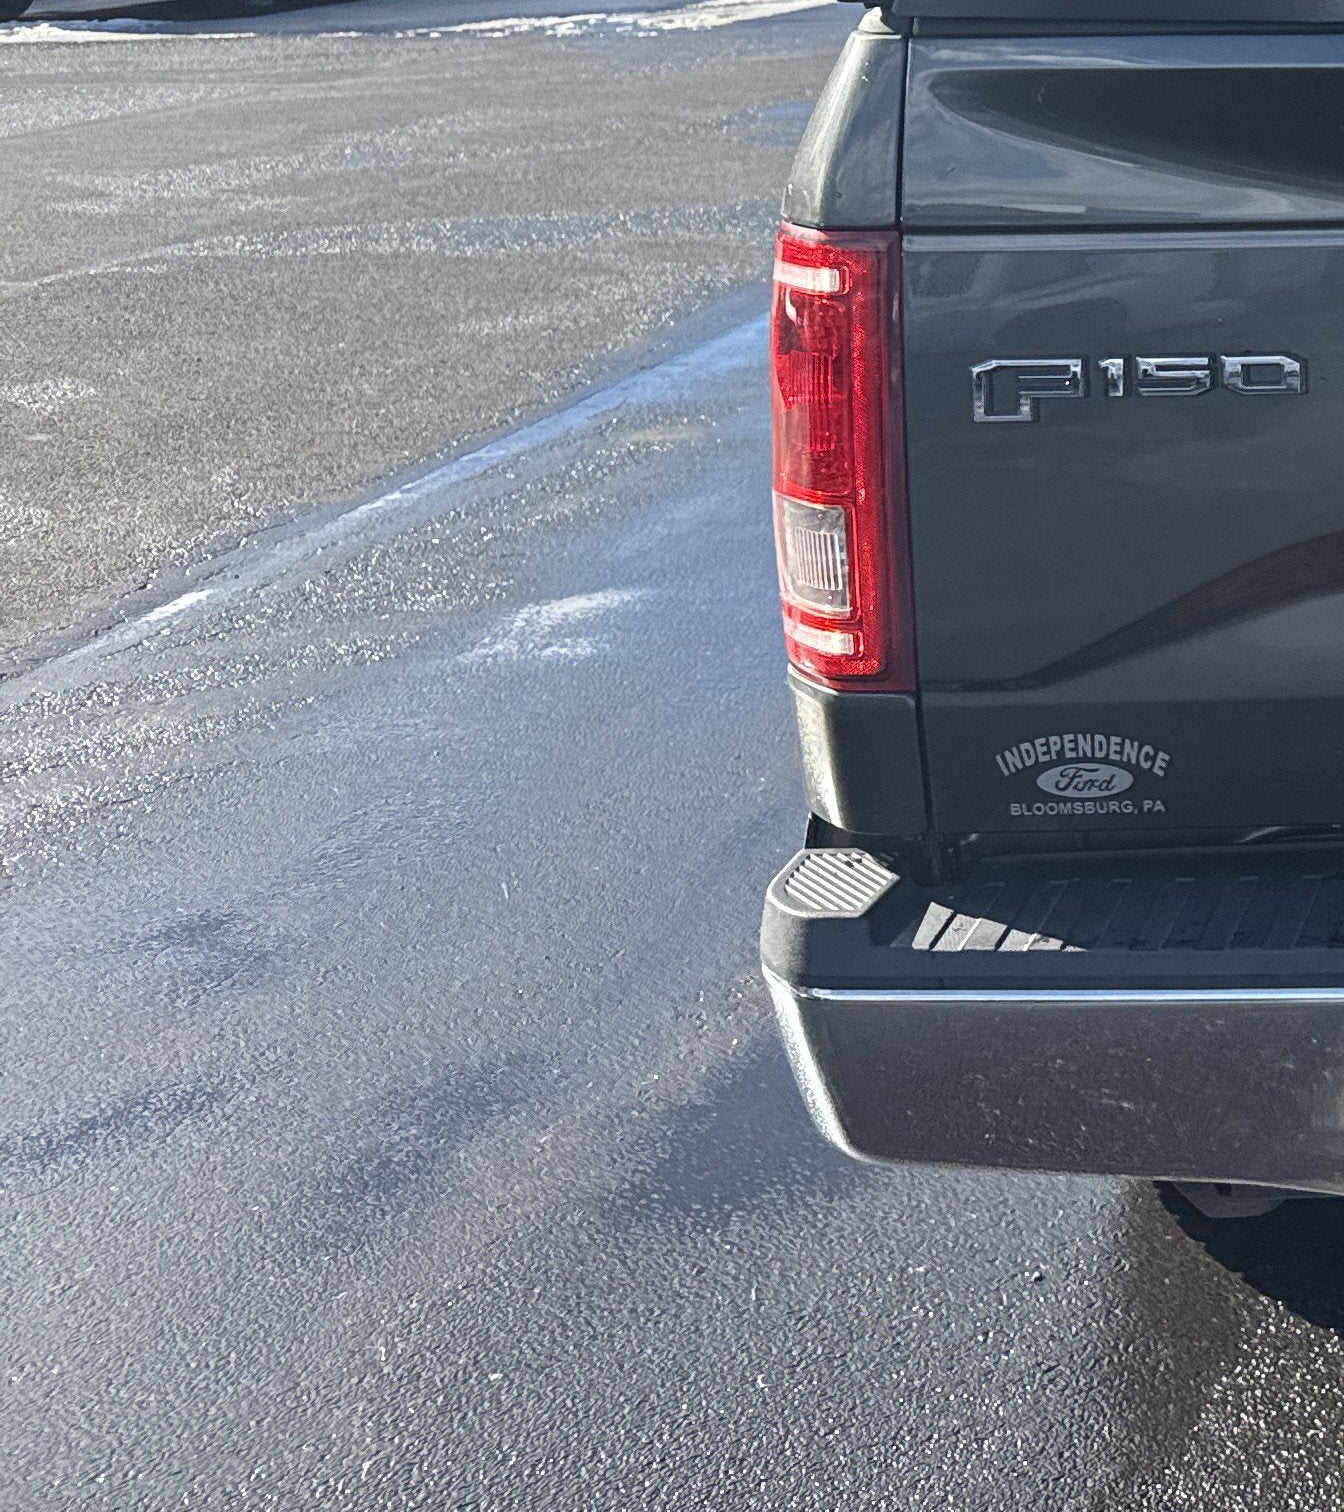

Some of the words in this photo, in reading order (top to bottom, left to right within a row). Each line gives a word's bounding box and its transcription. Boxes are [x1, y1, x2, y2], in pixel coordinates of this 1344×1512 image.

[995, 733, 1171, 777] INDEPENDENCE
[1055, 766, 1118, 792] Ford
[1010, 800, 1139, 816] BLOOMSBURG,
[1143, 800, 1166, 813] PA
